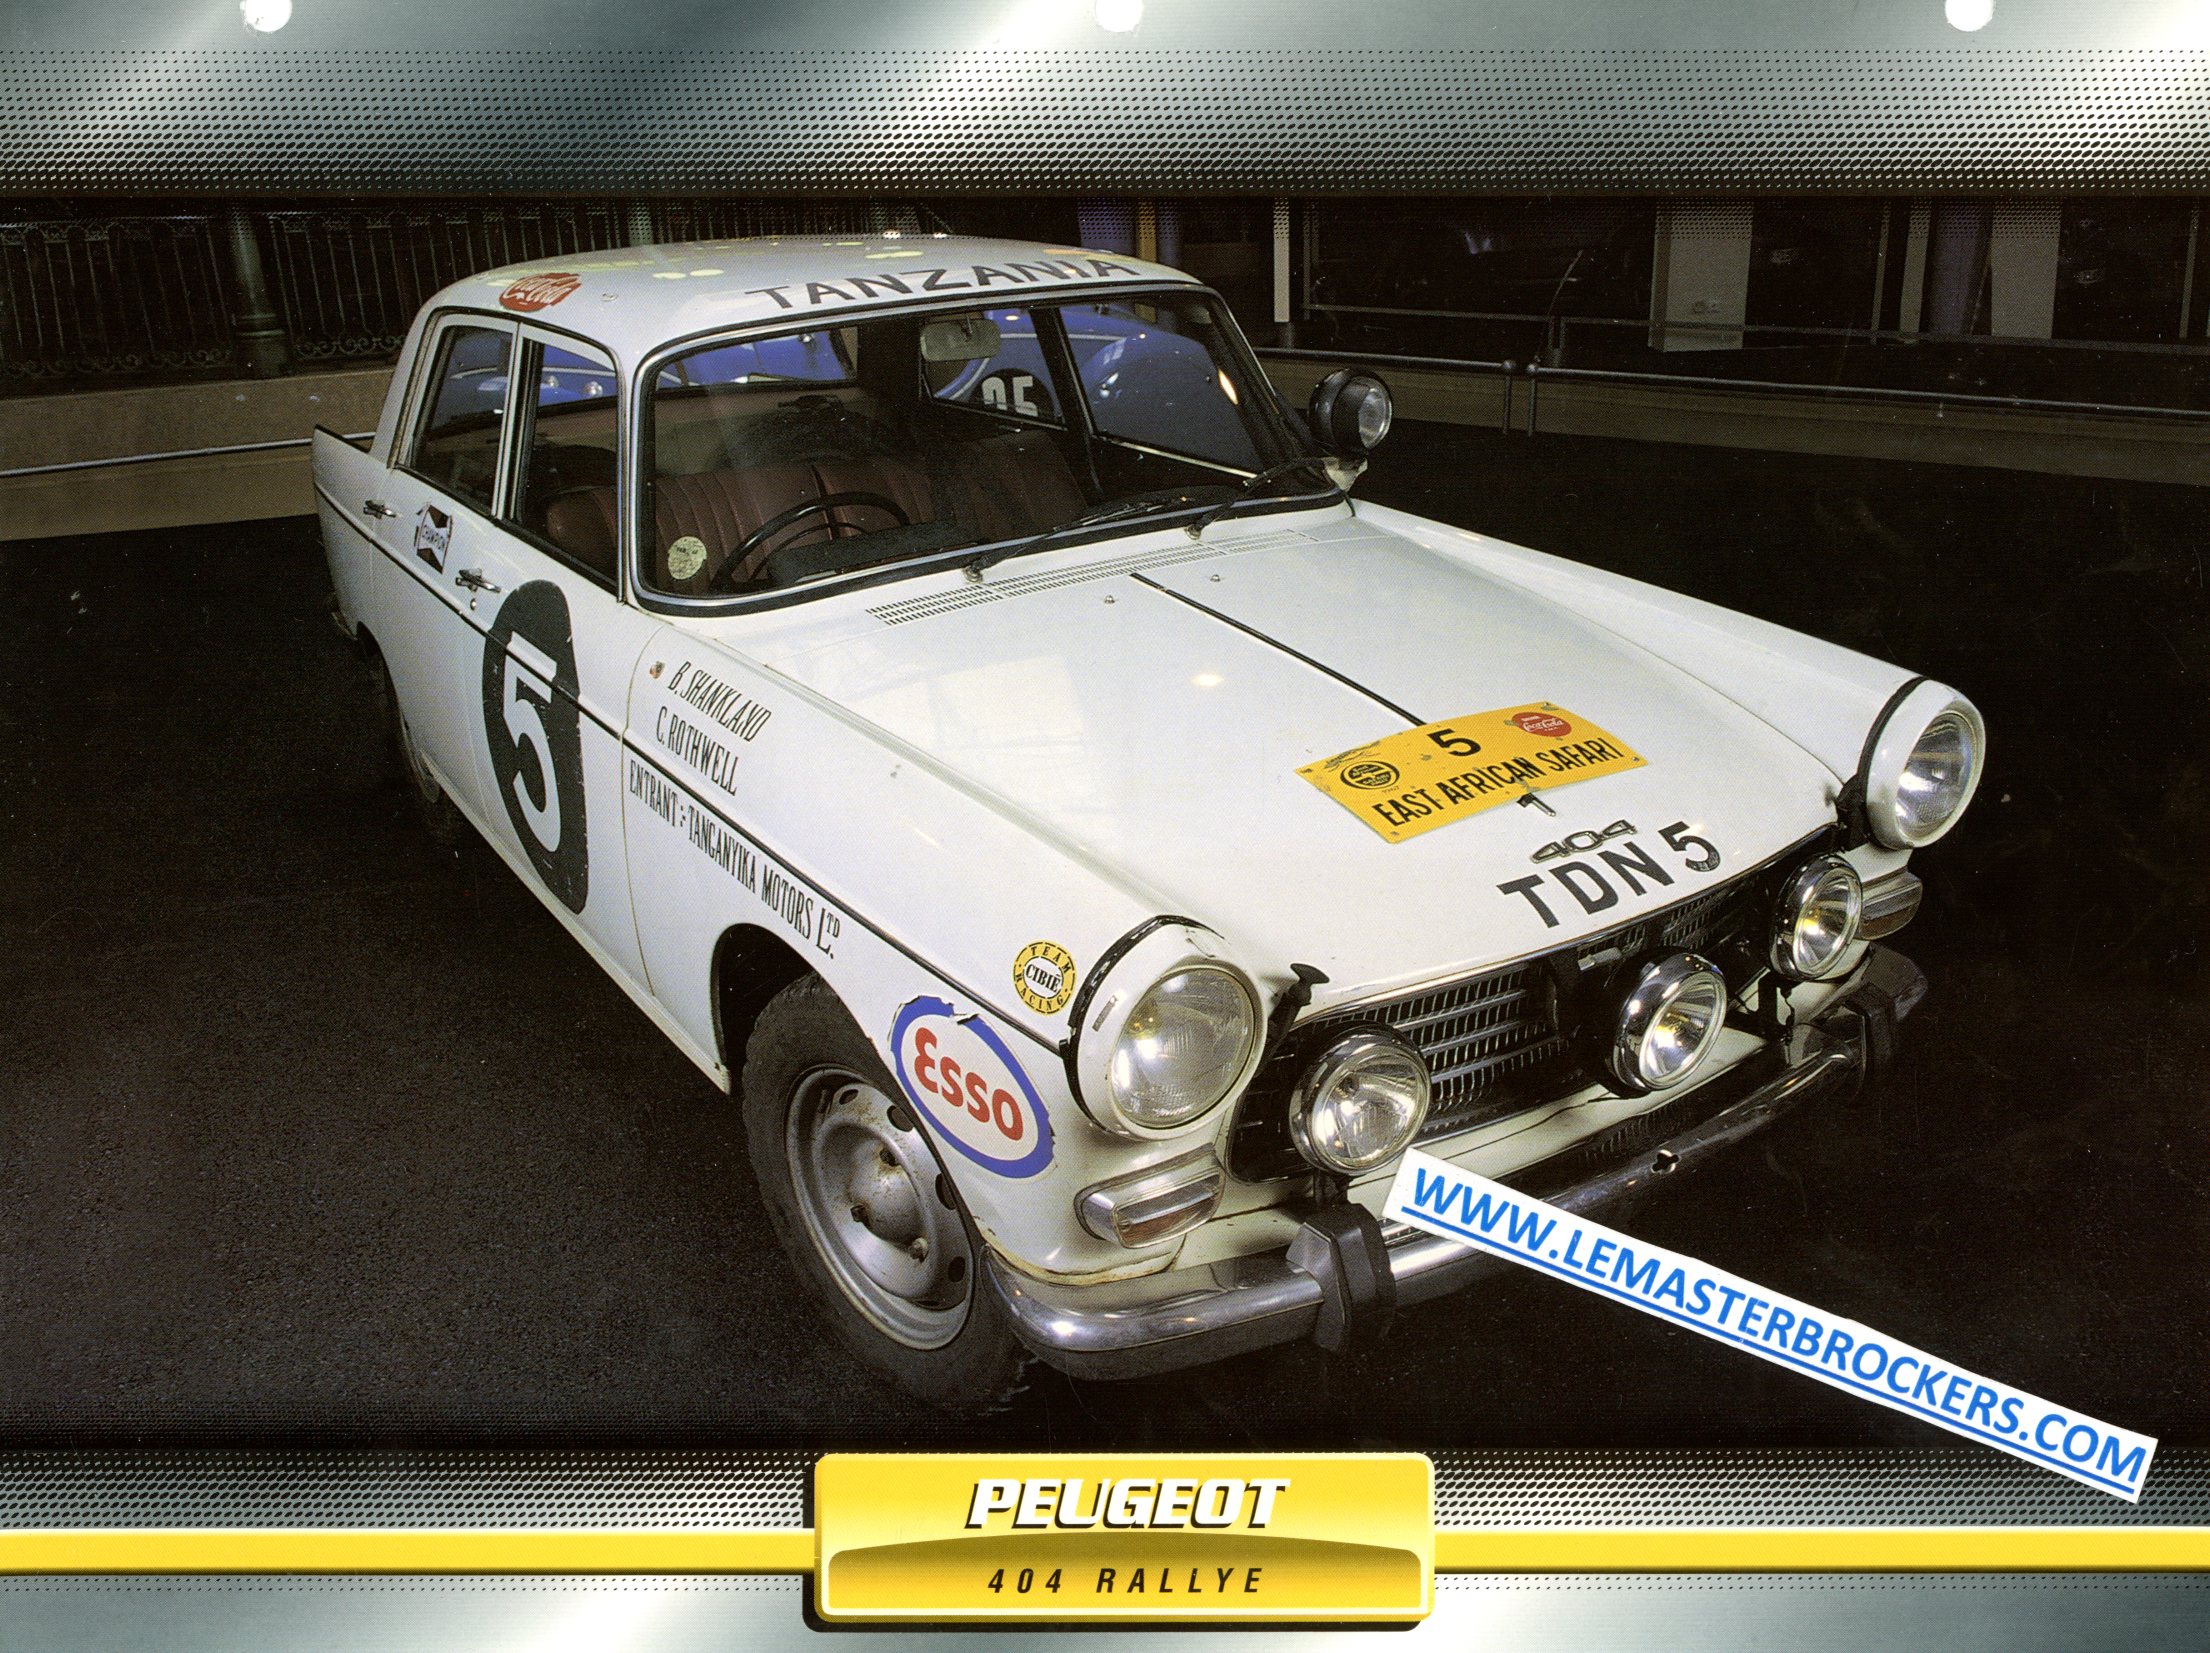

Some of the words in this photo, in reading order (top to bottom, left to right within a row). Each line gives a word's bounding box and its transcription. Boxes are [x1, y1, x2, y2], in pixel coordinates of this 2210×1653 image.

[745, 259, 1138, 309] TANZANIA
[503, 631, 562, 853] 5
[1427, 728, 1482, 757] 5
[1372, 787, 1444, 827] EAST
[1435, 751, 1547, 805] AFRICAN
[1538, 737, 1624, 773] SAFARI
[1529, 819, 1638, 864] 404
[689, 805, 756, 894] TANGANYIKA
[761, 864, 814, 940] MOTORS
[1496, 841, 1675, 928] TDN
[1657, 821, 1721, 872] 5
[1031, 946, 1072, 973] TEAM
[1015, 974, 1064, 1011] RACING
